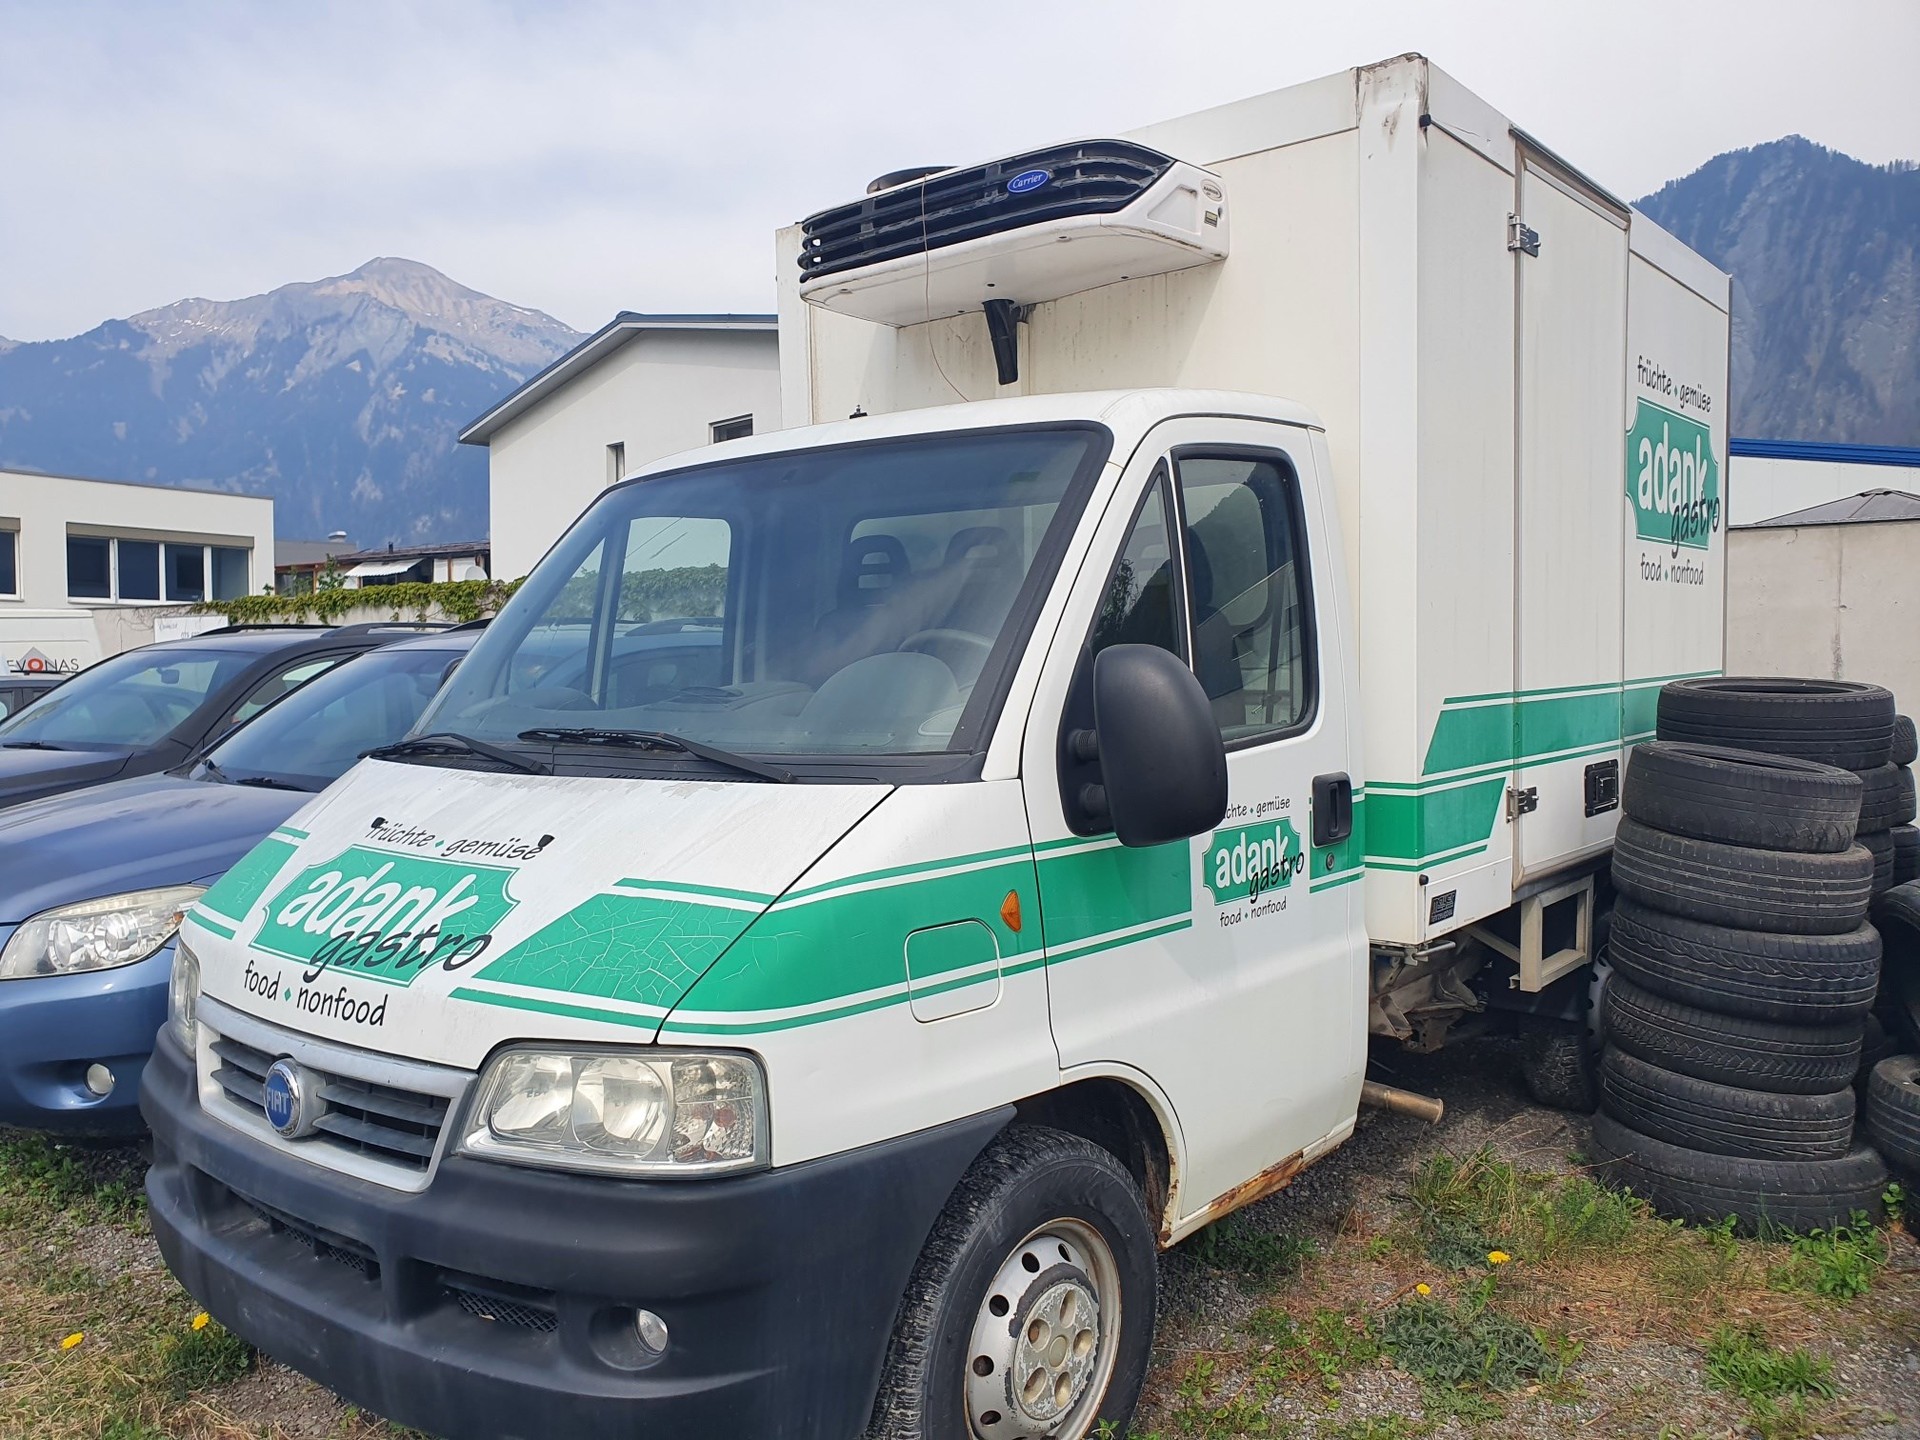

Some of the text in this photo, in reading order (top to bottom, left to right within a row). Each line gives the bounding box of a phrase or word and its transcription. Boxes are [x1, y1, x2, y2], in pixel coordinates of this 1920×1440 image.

[1012, 173, 1043, 189] Carrier
[1637, 355, 1711, 412] früchte gemüse
[1638, 421, 1708, 513] adank
[1671, 496, 1720, 559] gastro
[1640, 553, 1704, 586] food nonfood
[1226, 796, 1291, 819] chte gemüse
[365, 818, 545, 861] früchte gemüse
[1215, 825, 1289, 888] adank
[276, 861, 480, 948] adank
[1250, 852, 1304, 904] gastro
[1220, 896, 1287, 927] food nonfood
[302, 924, 493, 983] gastro
[243, 960, 388, 1027] food nonfood
[266, 1087, 289, 1115] FIAT
